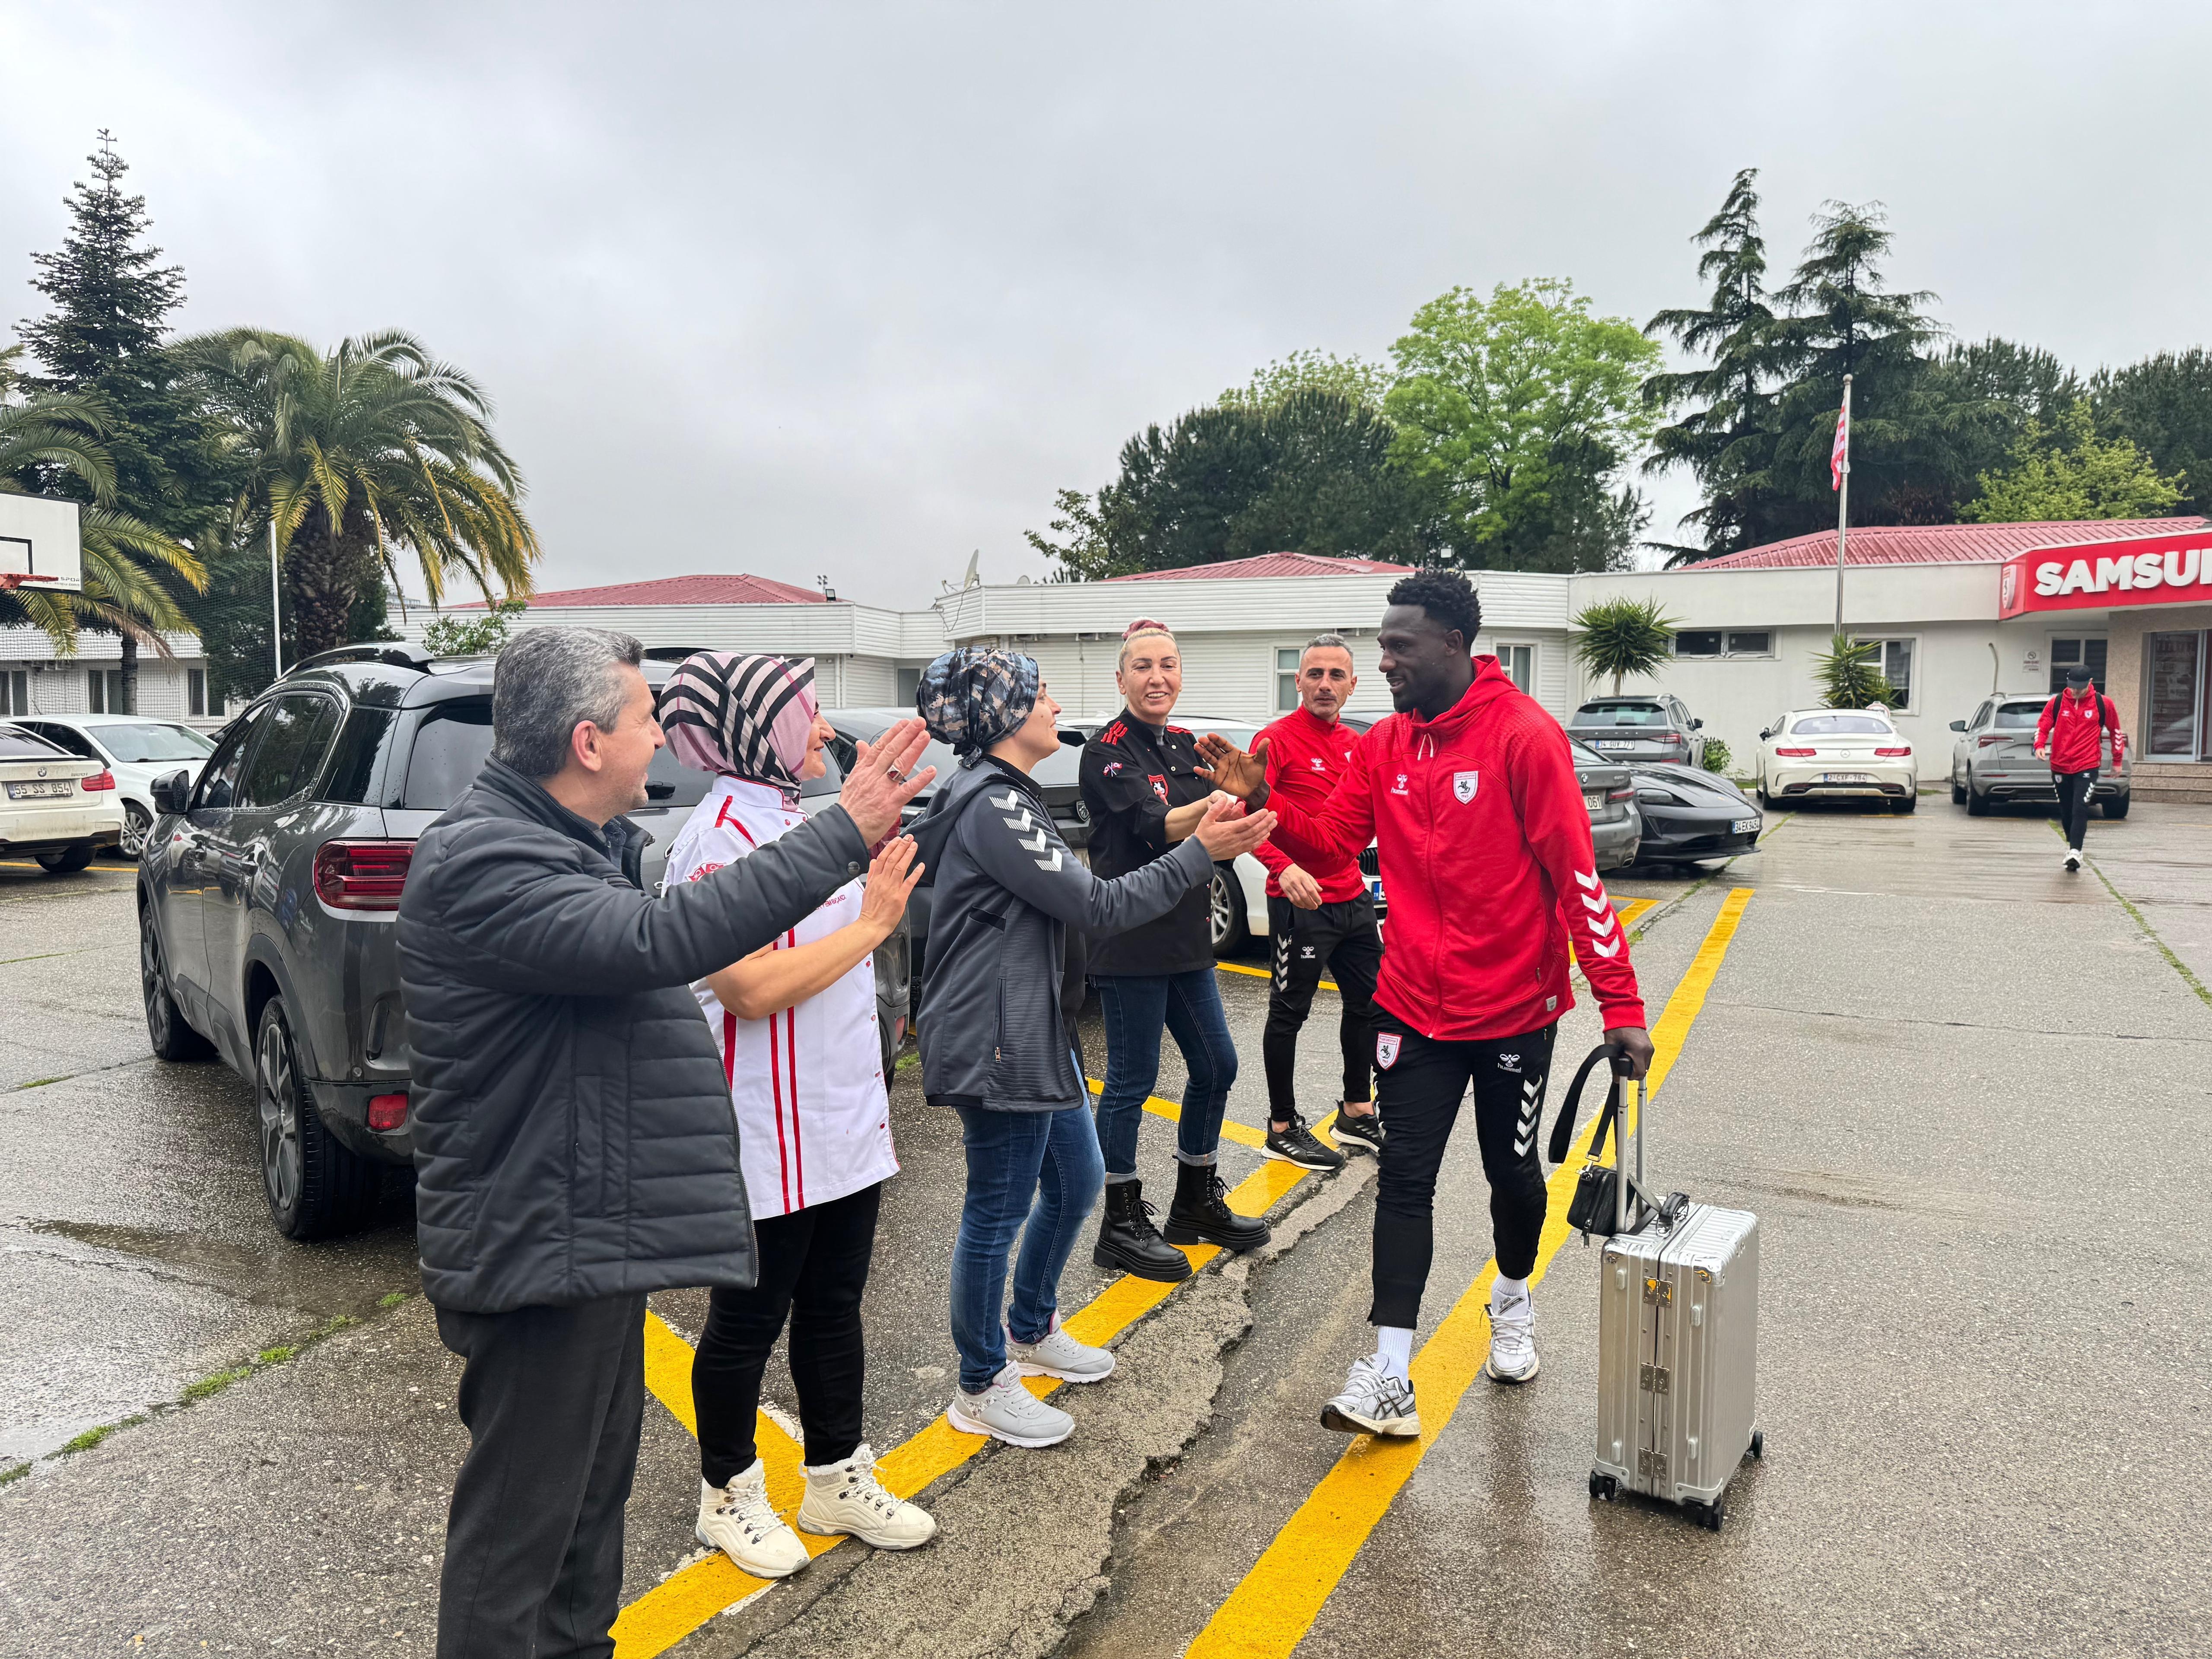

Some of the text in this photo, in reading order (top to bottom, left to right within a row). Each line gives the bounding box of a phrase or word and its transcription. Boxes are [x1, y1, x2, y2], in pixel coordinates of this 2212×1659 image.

[14, 783, 69, 795] 55 SS 854
[1588, 796, 1601, 808] 061
[1735, 822, 1742, 832] 34
[1742, 821, 1749, 831] EK
[1497, 1062, 1522, 1073] hummel
